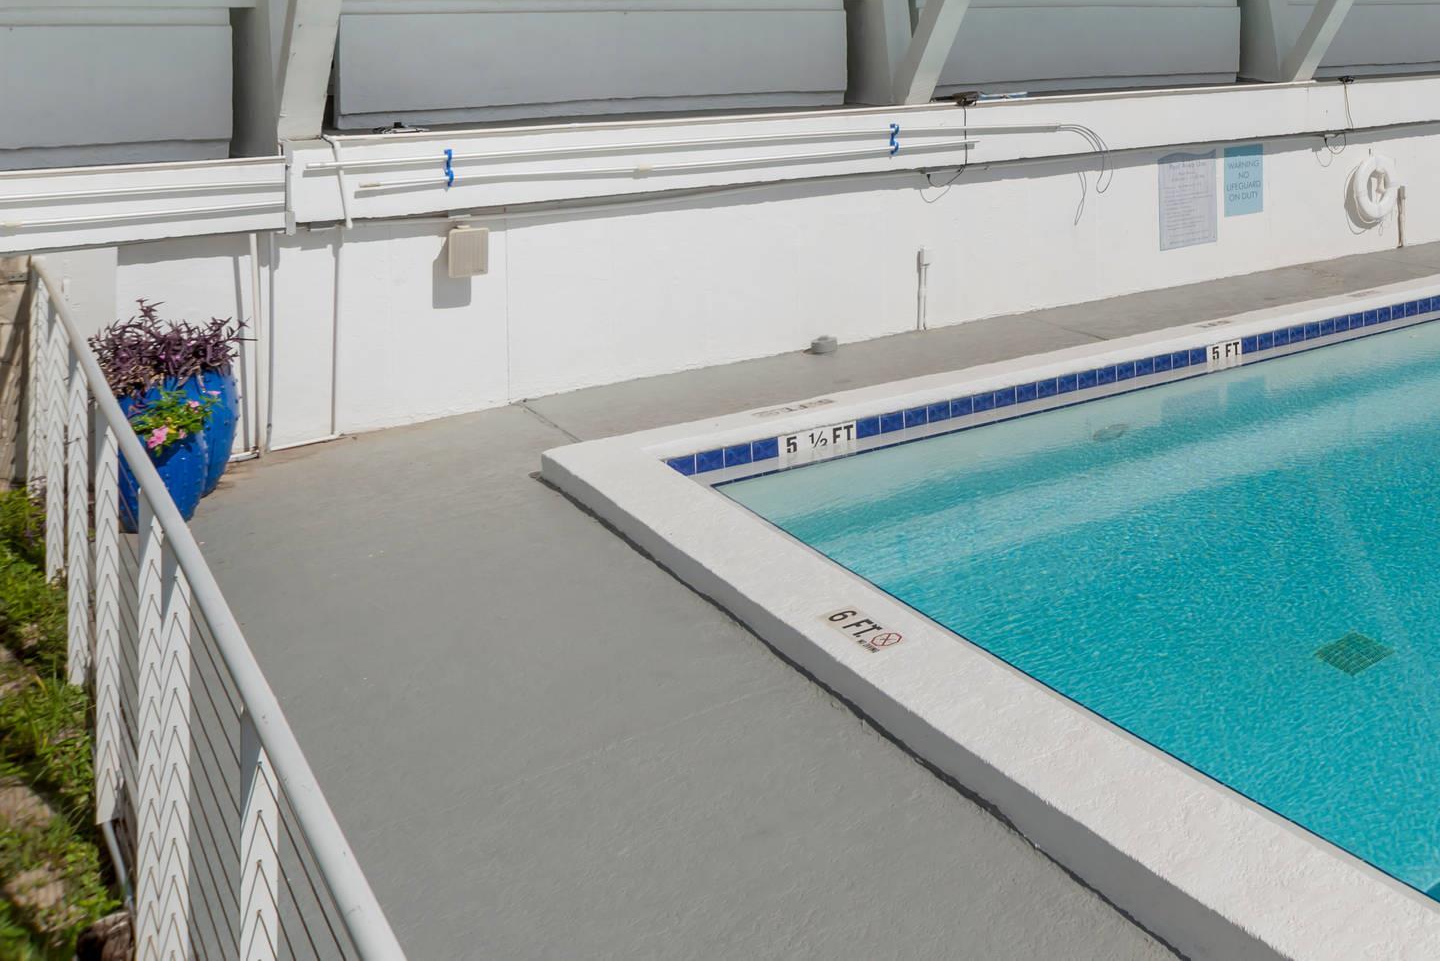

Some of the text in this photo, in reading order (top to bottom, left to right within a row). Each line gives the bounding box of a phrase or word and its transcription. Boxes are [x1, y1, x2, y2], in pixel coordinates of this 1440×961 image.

[1228, 159, 1260, 169] WARNING
[1238, 171, 1250, 179] NO
[1226, 180, 1261, 191] LIFEGUARD
[1228, 190, 1258, 202] ON DUTY
[1212, 341, 1240, 360] 5 FT
[786, 436, 797, 453] 5
[832, 424, 854, 444] FT
[828, 610, 858, 622] 6
